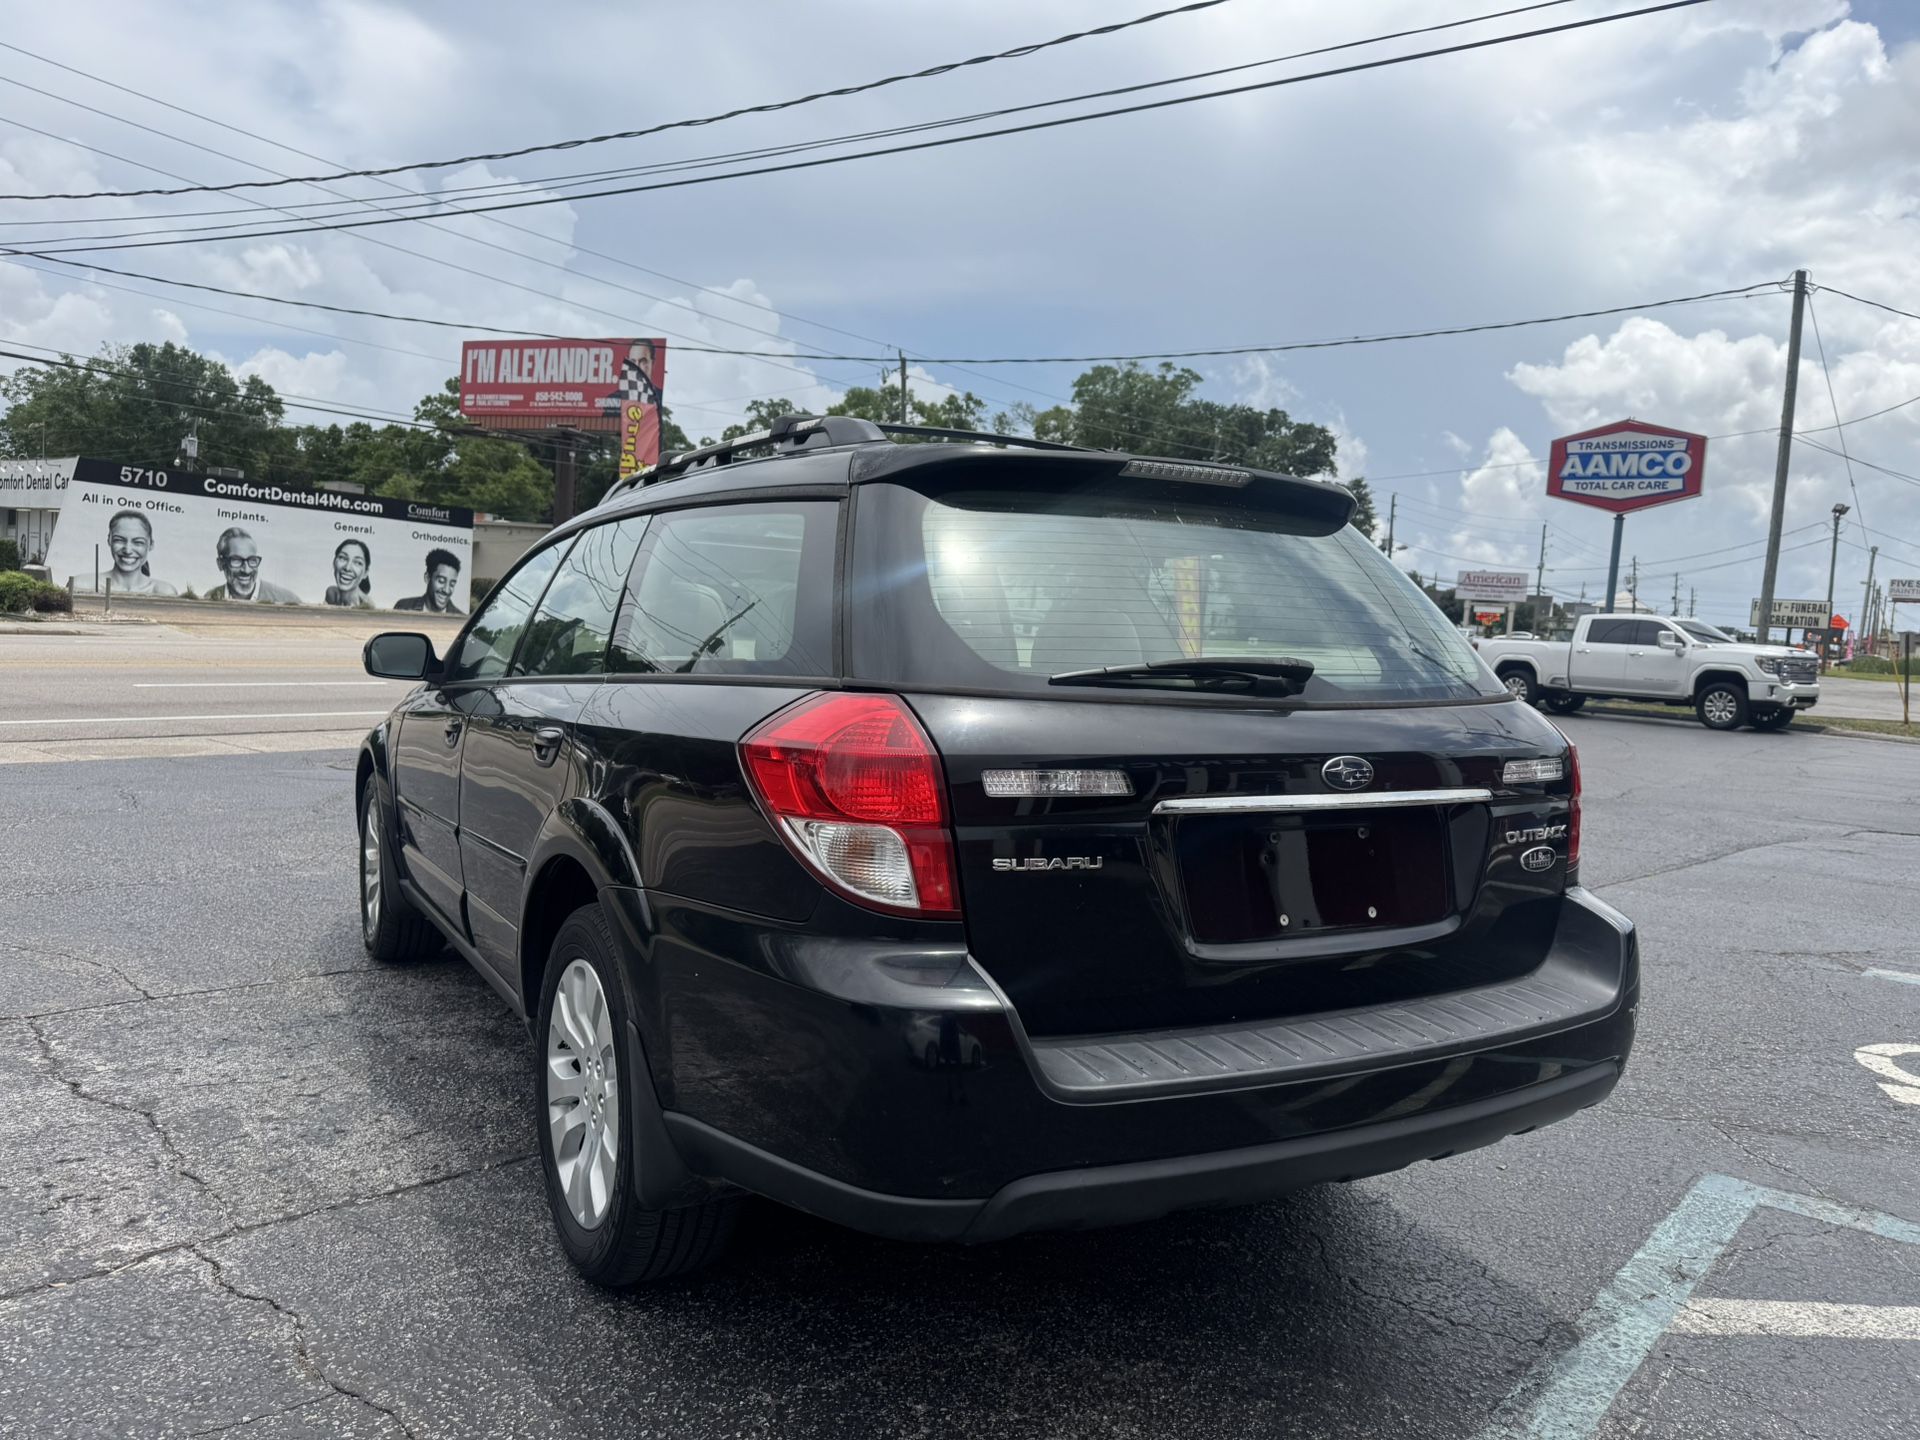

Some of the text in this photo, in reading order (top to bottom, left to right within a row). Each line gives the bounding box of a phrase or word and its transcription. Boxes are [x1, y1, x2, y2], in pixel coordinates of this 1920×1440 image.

[465, 347, 618, 383] I'M ALEXANDER.
[1579, 440, 1674, 450] TRANSMISSIONS
[1559, 451, 1692, 477] AAMCO
[26, 473, 52, 489] Dental
[119, 465, 168, 488] 5710
[1575, 481, 1669, 490] TOTAL CAR CARE
[82, 493, 185, 514] All in One Office.
[203, 478, 383, 514] ComfortDental4Me.com
[217, 508, 269, 523] Implants.
[407, 503, 450, 519] Comfort
[334, 521, 375, 535] General.
[411, 531, 470, 546] Orthodontics.
[1463, 573, 1521, 585] American
[1890, 579, 1913, 588] FIVE
[1791, 603, 1827, 614] FUNERAL
[1770, 615, 1819, 627] CREMATION
[1506, 825, 1567, 844] OUTBACK
[992, 856, 1103, 871] SUBARU
